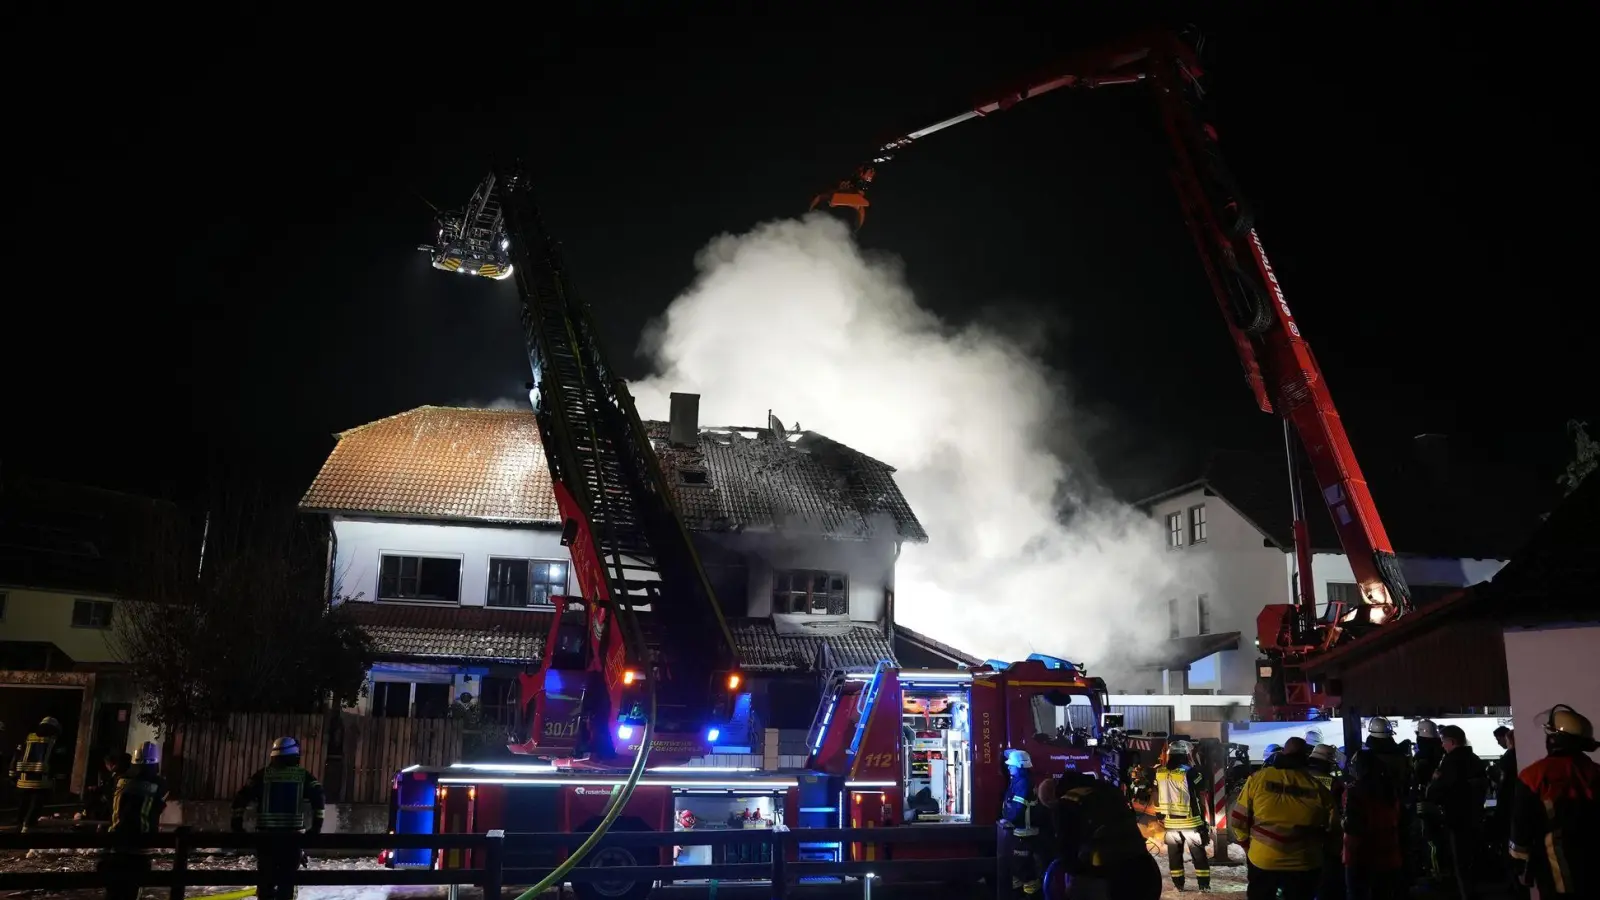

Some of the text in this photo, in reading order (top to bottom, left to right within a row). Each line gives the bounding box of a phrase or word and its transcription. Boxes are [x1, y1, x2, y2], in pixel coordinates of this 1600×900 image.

[982, 712, 990, 726] 3.0
[544, 721, 574, 738] 30/1
[865, 752, 893, 768] 112
